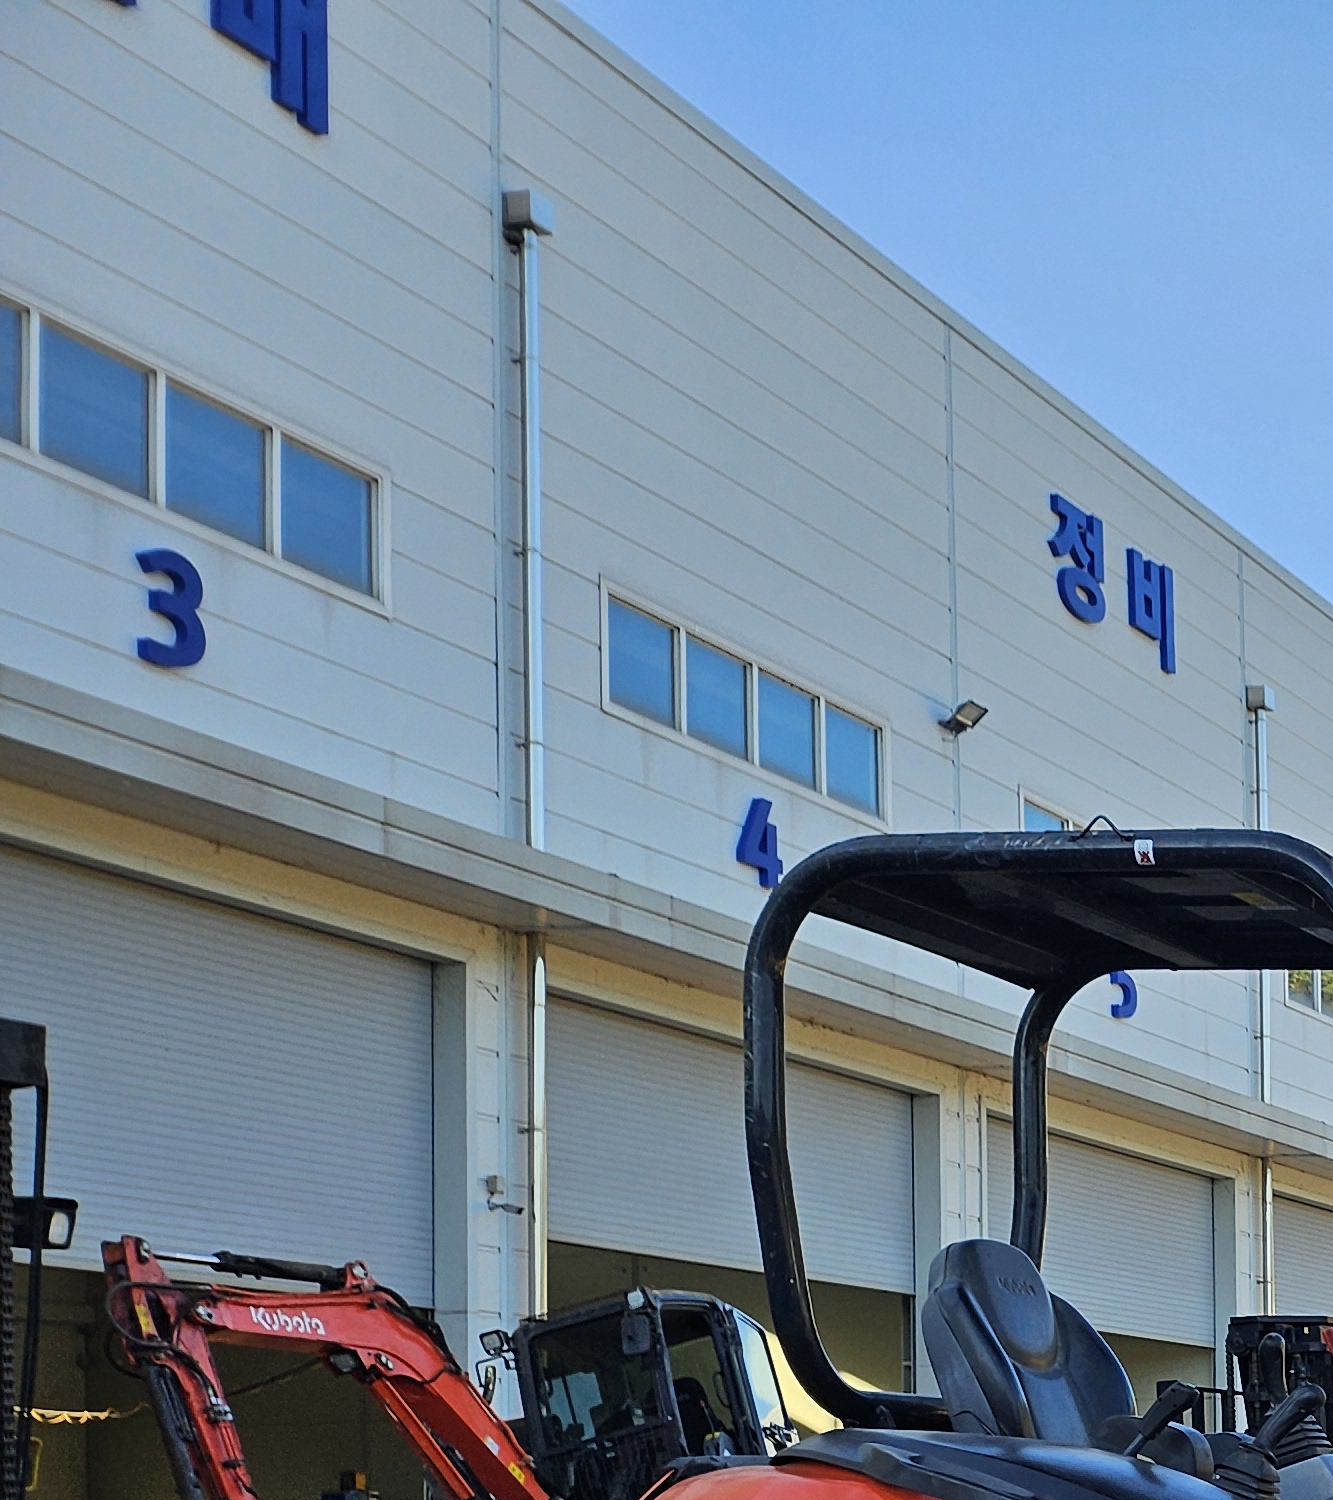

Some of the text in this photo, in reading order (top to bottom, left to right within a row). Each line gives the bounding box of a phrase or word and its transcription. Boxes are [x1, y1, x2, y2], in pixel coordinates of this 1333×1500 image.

[135, 548, 206, 667] 3
[1047, 493, 1176, 674] 정비
[736, 798, 783, 888] 4
[249, 1305, 326, 1335] Kubota
